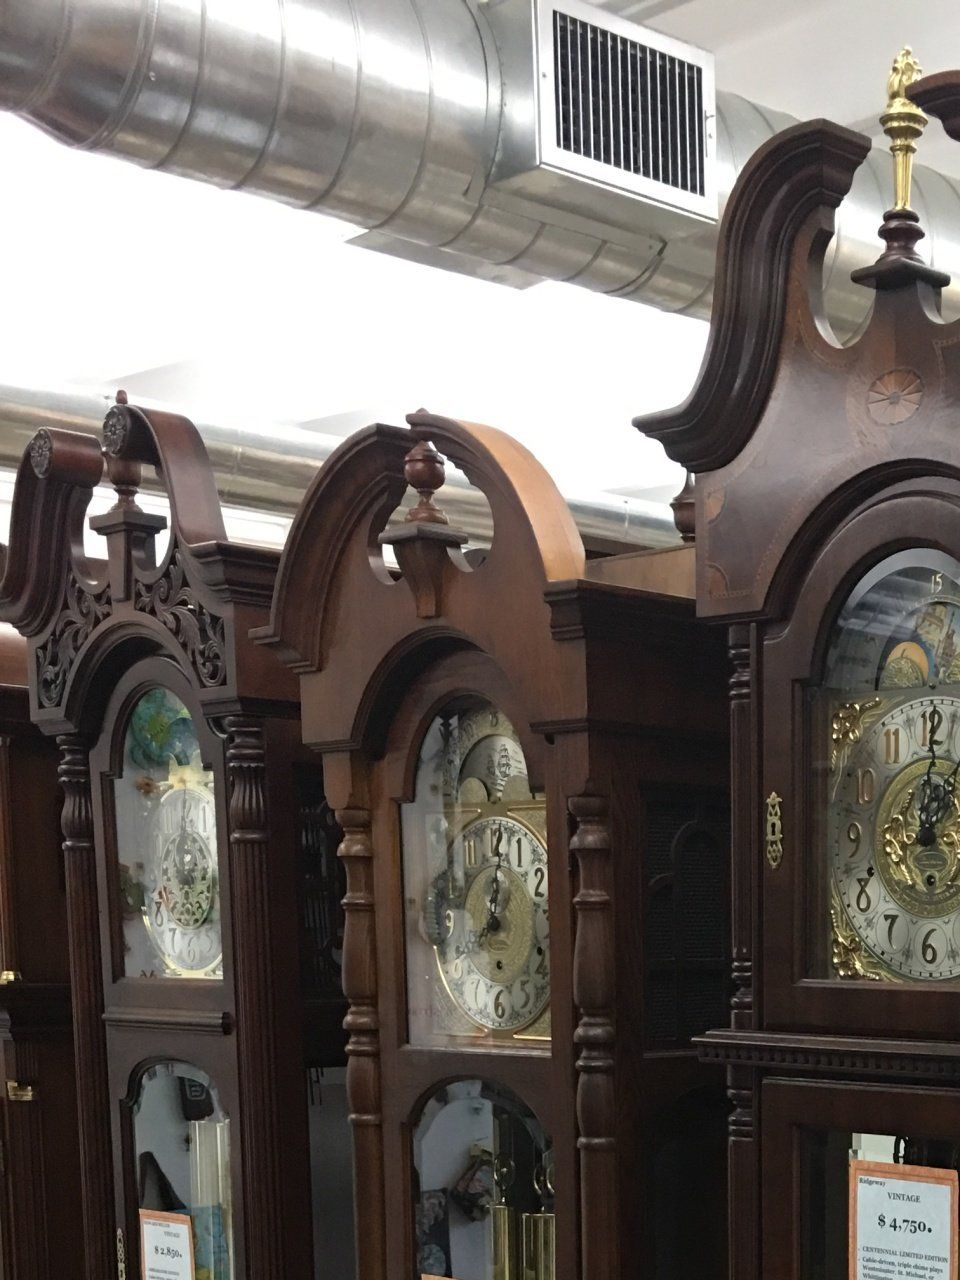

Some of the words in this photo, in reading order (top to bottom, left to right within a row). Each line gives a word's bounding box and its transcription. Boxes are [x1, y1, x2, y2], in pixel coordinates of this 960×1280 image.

[931, 573, 943, 594] 15
[884, 728, 900, 764] 11
[856, 768, 875, 805] 10
[464, 840, 476, 867] 11
[516, 837, 523, 868] 1
[848, 822, 862, 858] 9
[534, 867, 545, 897] 2
[856, 878, 872, 913] 8
[155, 902, 163, 927] 8
[446, 909, 454, 938] 9
[169, 928, 177, 954] 7
[884, 914, 899, 949] 7
[922, 928, 937, 965] 6
[494, 989, 505, 1019] 6
[520, 979, 530, 1009] 5
[887, 1192, 921, 1203] VINTAGE
[878, 1213, 886, 1228] $
[862, 1246, 898, 1256] CENTENNIAL
[900, 1251, 924, 1260] LIMITED
[924, 1254, 948, 1263] EDITION
